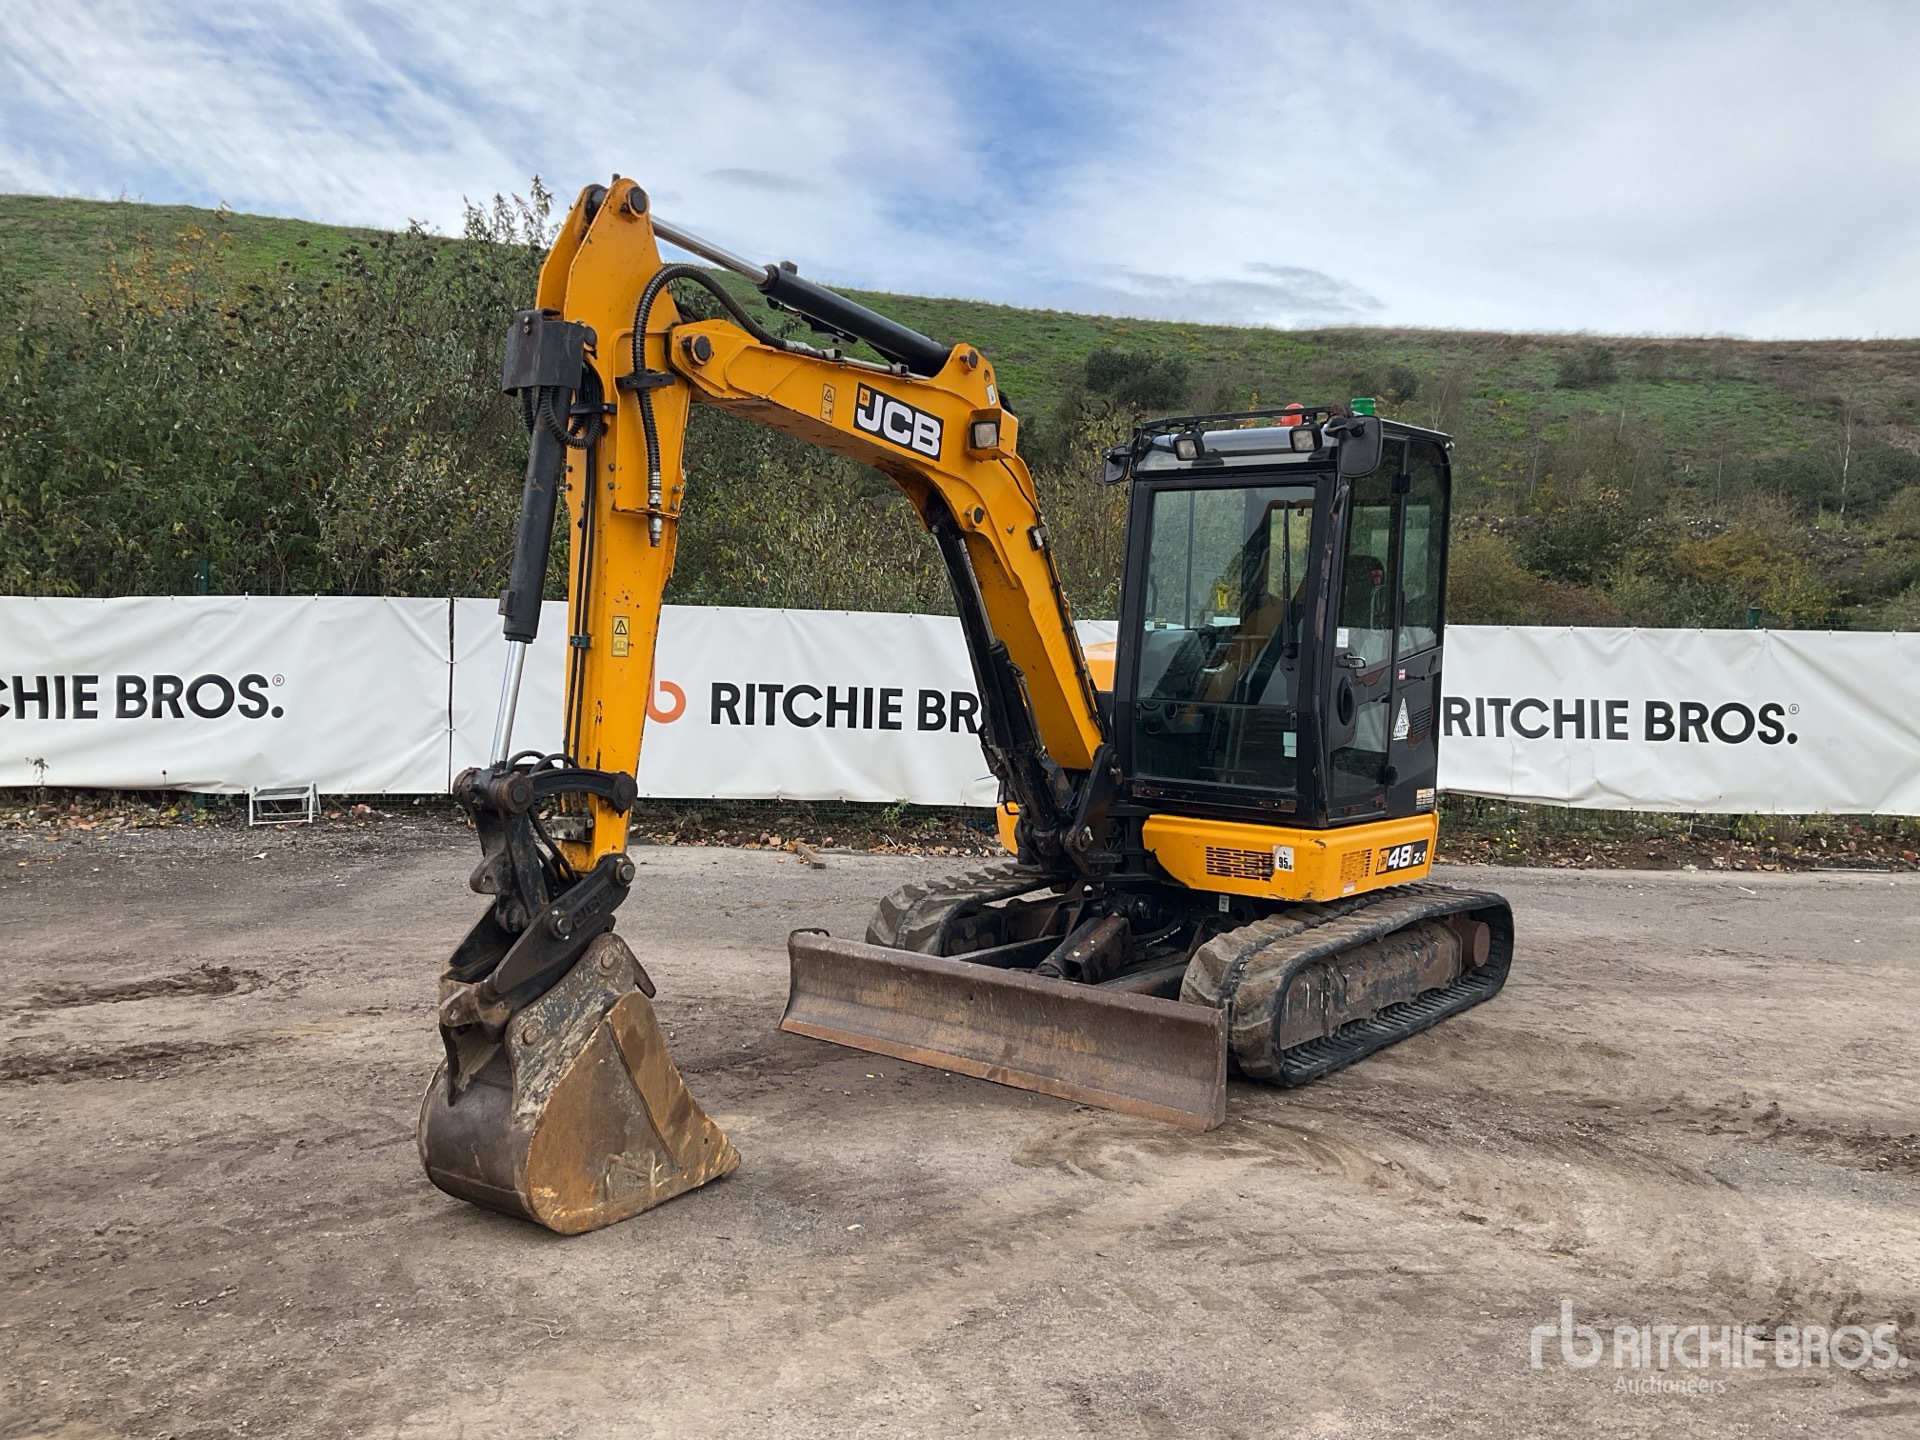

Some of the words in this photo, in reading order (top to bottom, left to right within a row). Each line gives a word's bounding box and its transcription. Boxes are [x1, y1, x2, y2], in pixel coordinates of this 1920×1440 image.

[857, 394, 941, 456] JCB
[0, 674, 98, 719] HIE
[710, 682, 903, 731] RITCHIE
[917, 689, 982, 734] BR
[1443, 696, 1629, 740] RITCHIE
[1388, 845, 1412, 869] 48
